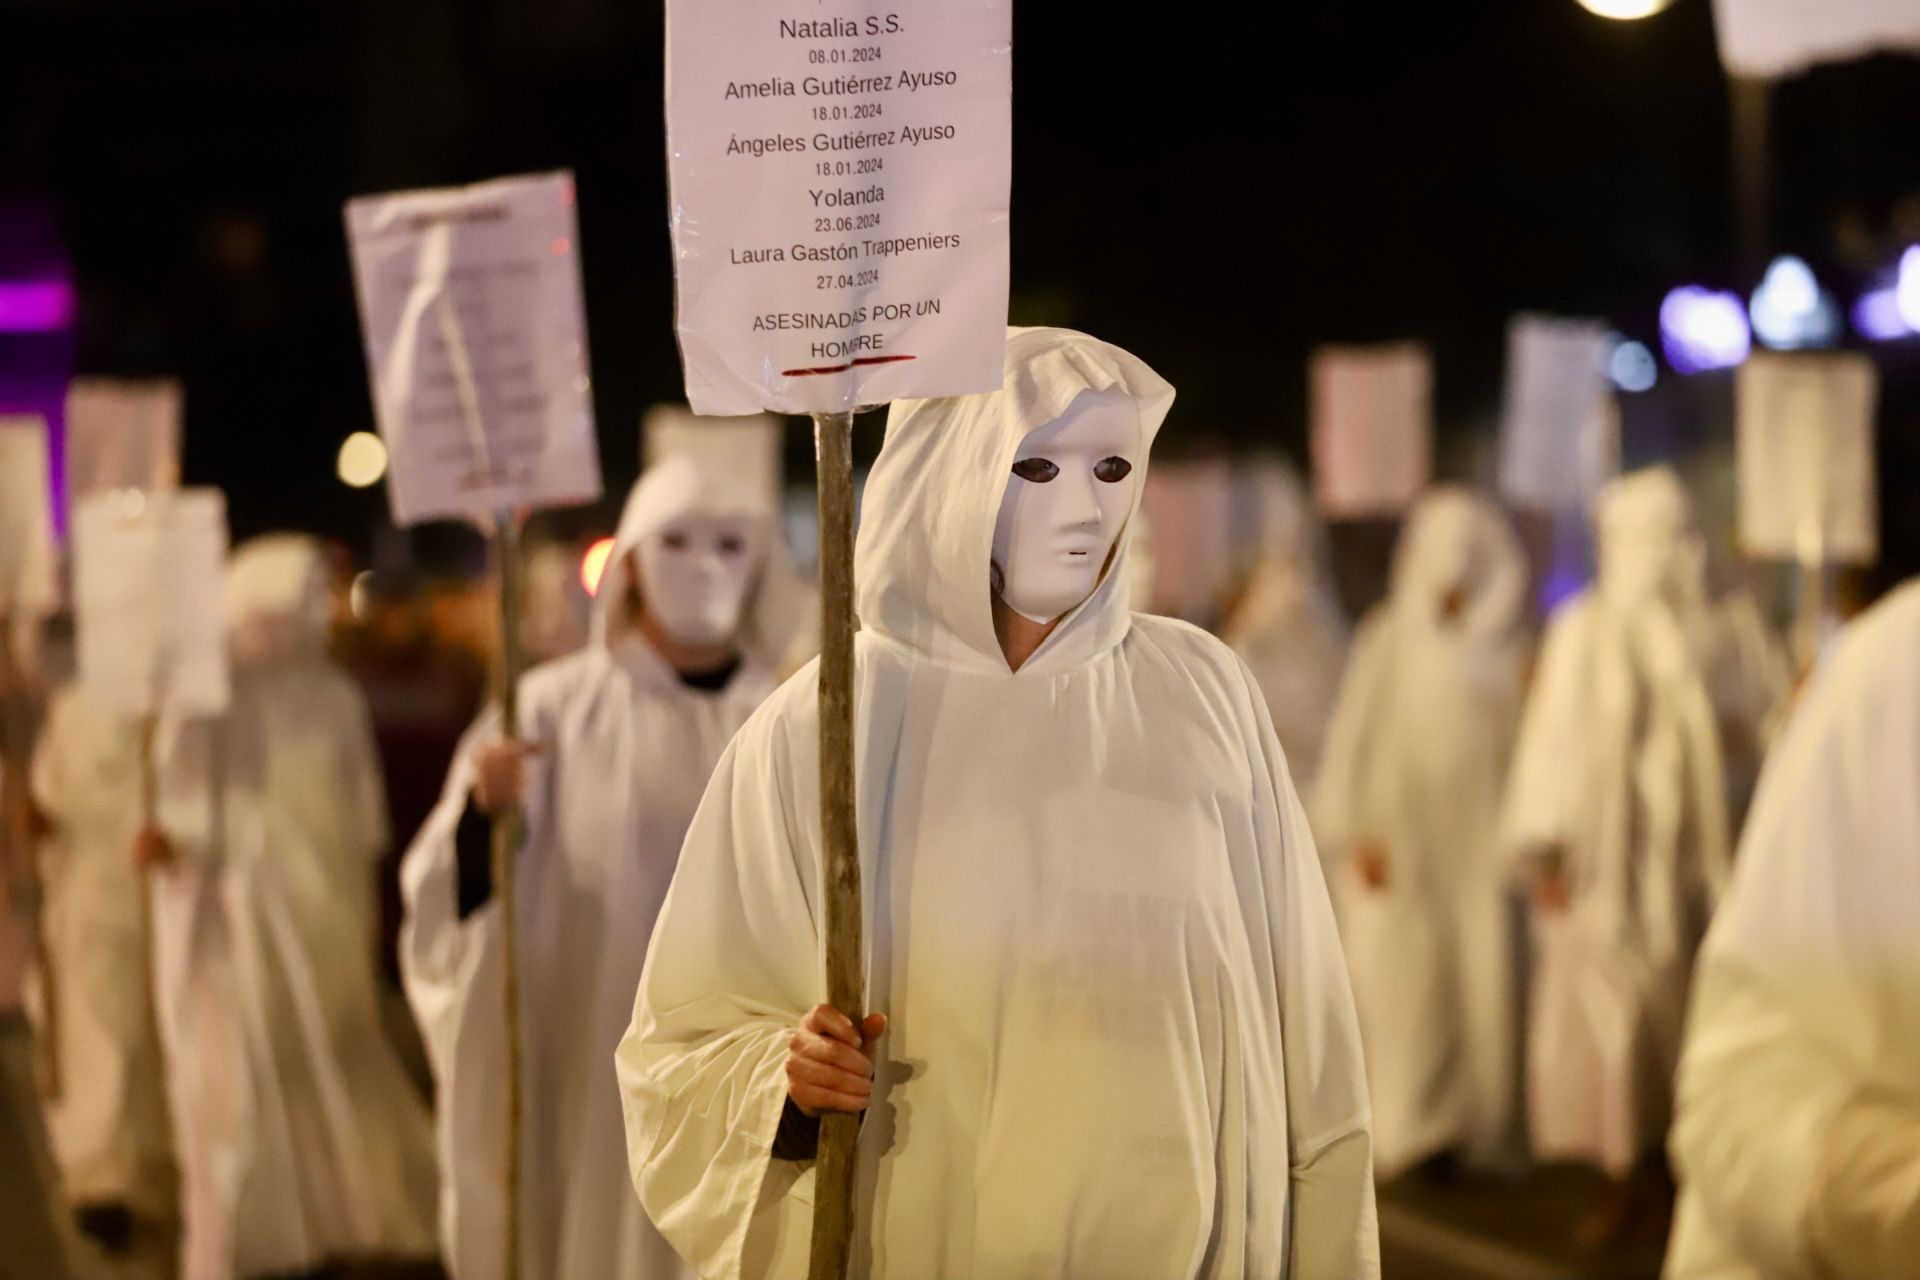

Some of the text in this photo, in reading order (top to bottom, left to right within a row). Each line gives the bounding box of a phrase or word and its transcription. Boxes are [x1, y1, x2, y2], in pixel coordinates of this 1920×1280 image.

[780, 14, 904, 39] Natalia S.S.
[809, 47, 881, 64] 08.01.2024
[725, 70, 957, 100] Amelia Gutiérrez Ayuso
[812, 104, 882, 120] 18.01.2024
[727, 124, 955, 157] Ángeles Gutiérrez Ayuso
[815, 158, 883, 176] 18.01.2024
[809, 185, 885, 207] Yolanda
[815, 214, 880, 232] 23.06.2024
[731, 232, 960, 265] Laura Gastón Trappeniers
[817, 270, 879, 290] 27.04.2024
[753, 299, 940, 332] ASESINADAS POR UN
